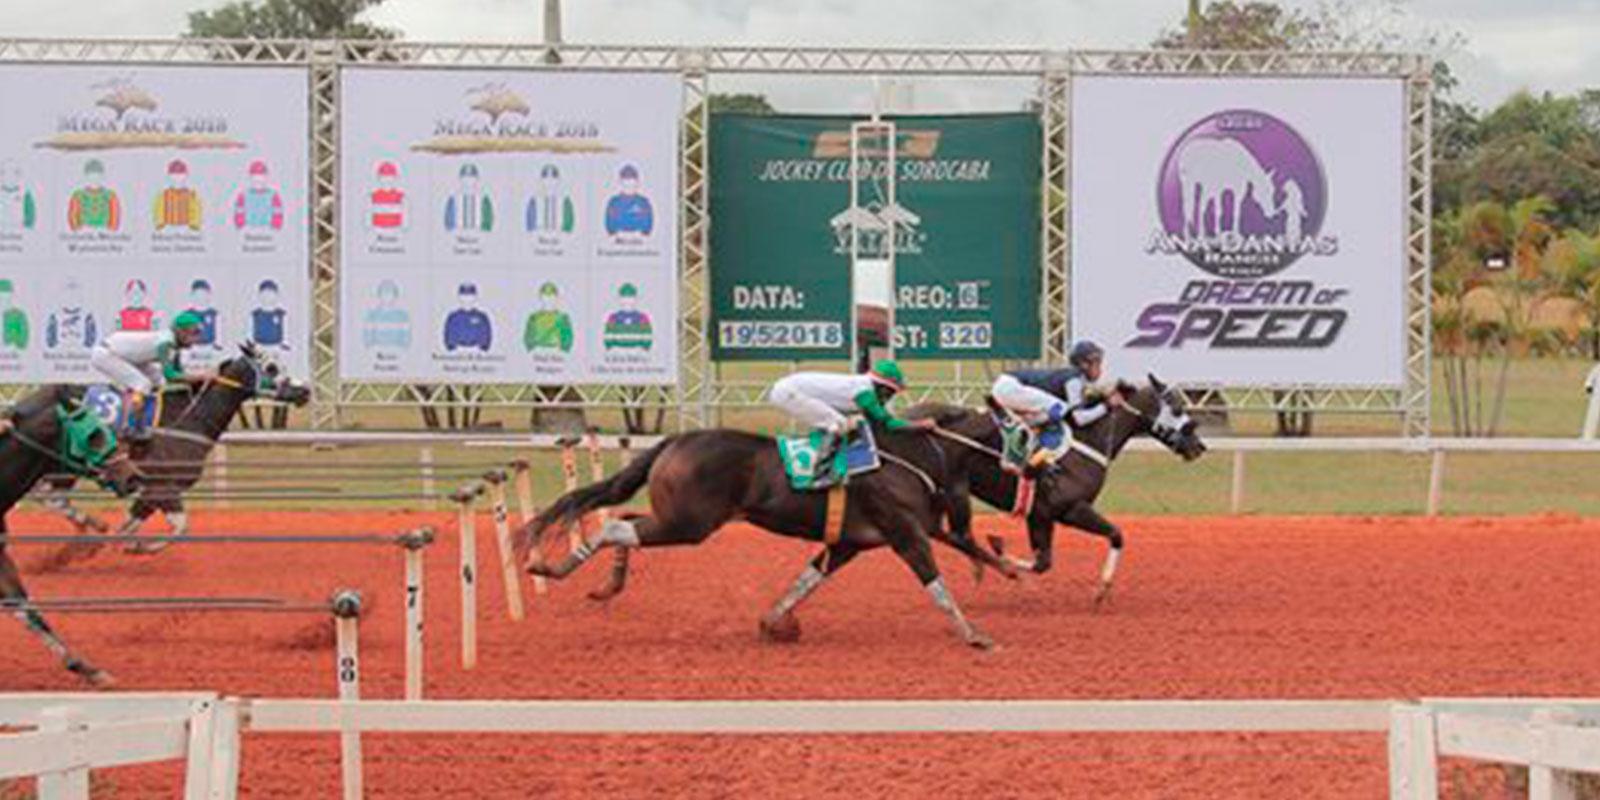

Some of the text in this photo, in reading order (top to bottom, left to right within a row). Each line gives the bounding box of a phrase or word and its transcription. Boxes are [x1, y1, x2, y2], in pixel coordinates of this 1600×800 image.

[759, 159, 825, 181] JOCKEY
[901, 159, 992, 181] SOROCABA
[733, 285, 804, 309] DATA:
[1179, 280, 1314, 305] DREAM
[941, 325, 990, 345] 320
[1123, 302, 1349, 349] SPEED
[407, 585, 418, 608] 7
